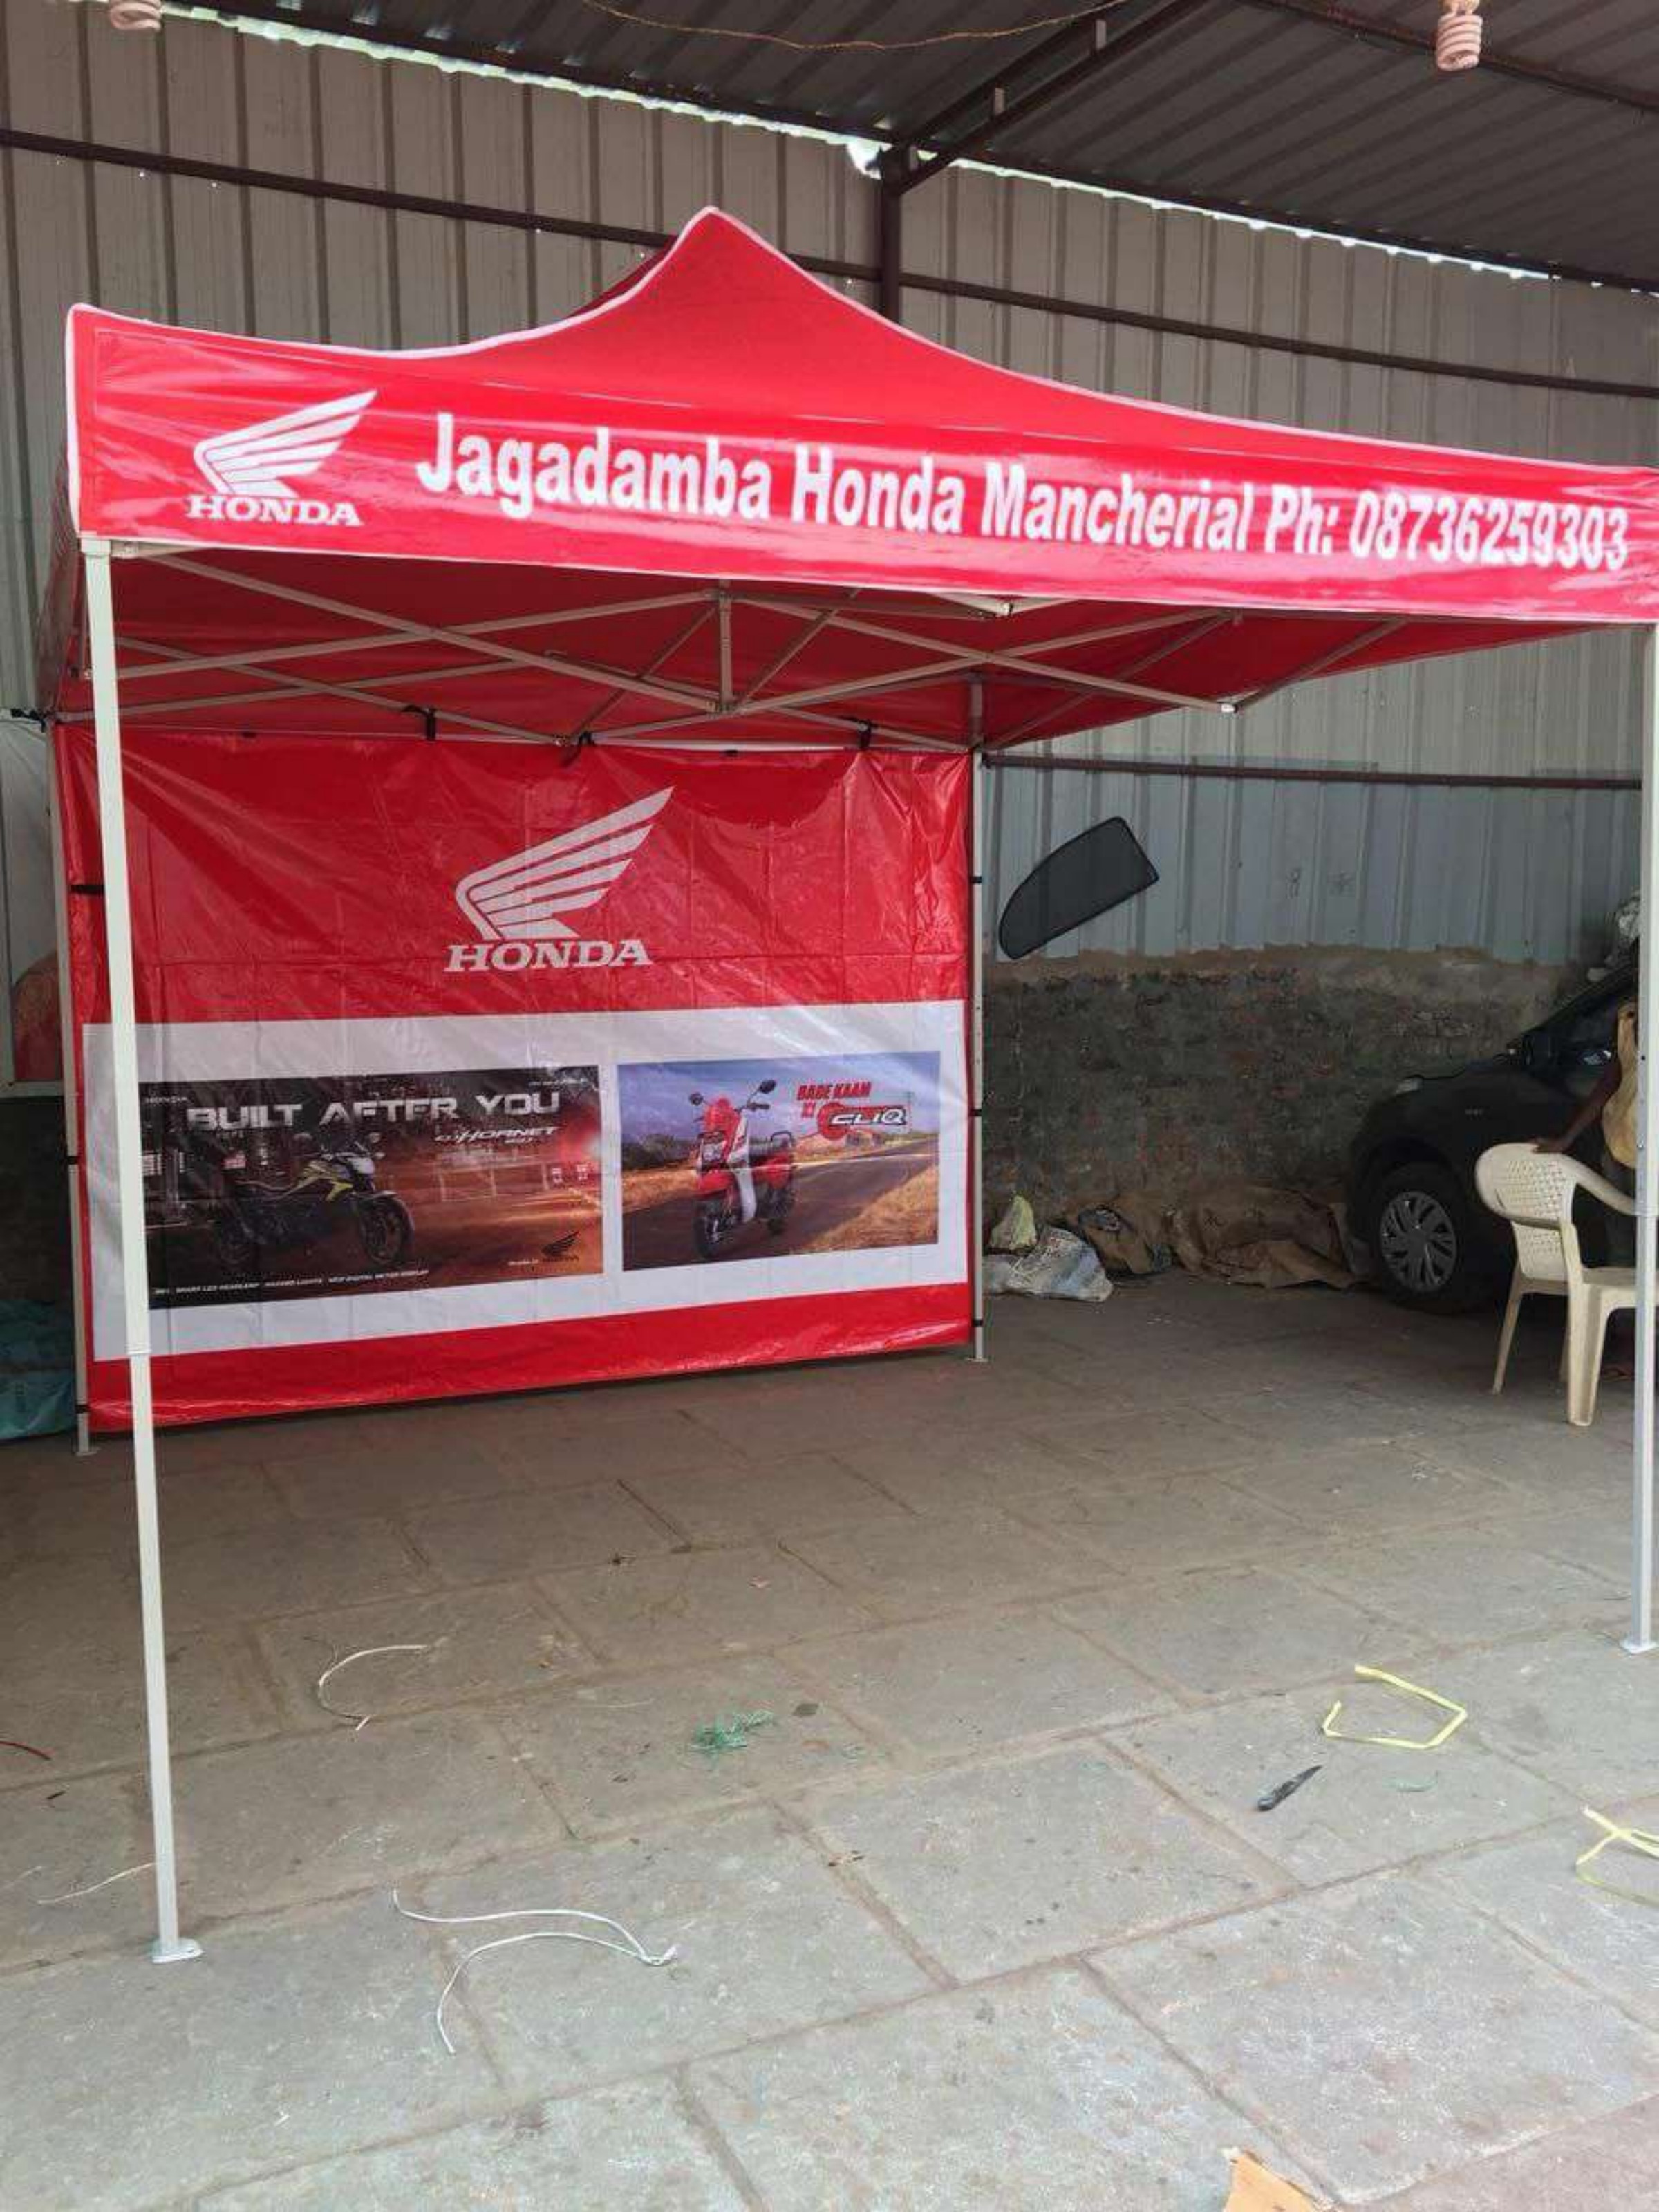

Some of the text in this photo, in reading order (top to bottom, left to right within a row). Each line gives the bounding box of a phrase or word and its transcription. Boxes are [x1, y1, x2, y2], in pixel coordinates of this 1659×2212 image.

[416, 413, 1629, 571] Jagadamba Honda Mancherial Ph: 08736259303
[185, 494, 364, 527] HONDA
[444, 939, 655, 973] HONDA
[187, 1091, 561, 1130] BUILT AFTER YOU
[831, 1107, 907, 1126] CLIQ
[455, 1126, 560, 1144] HORNET
